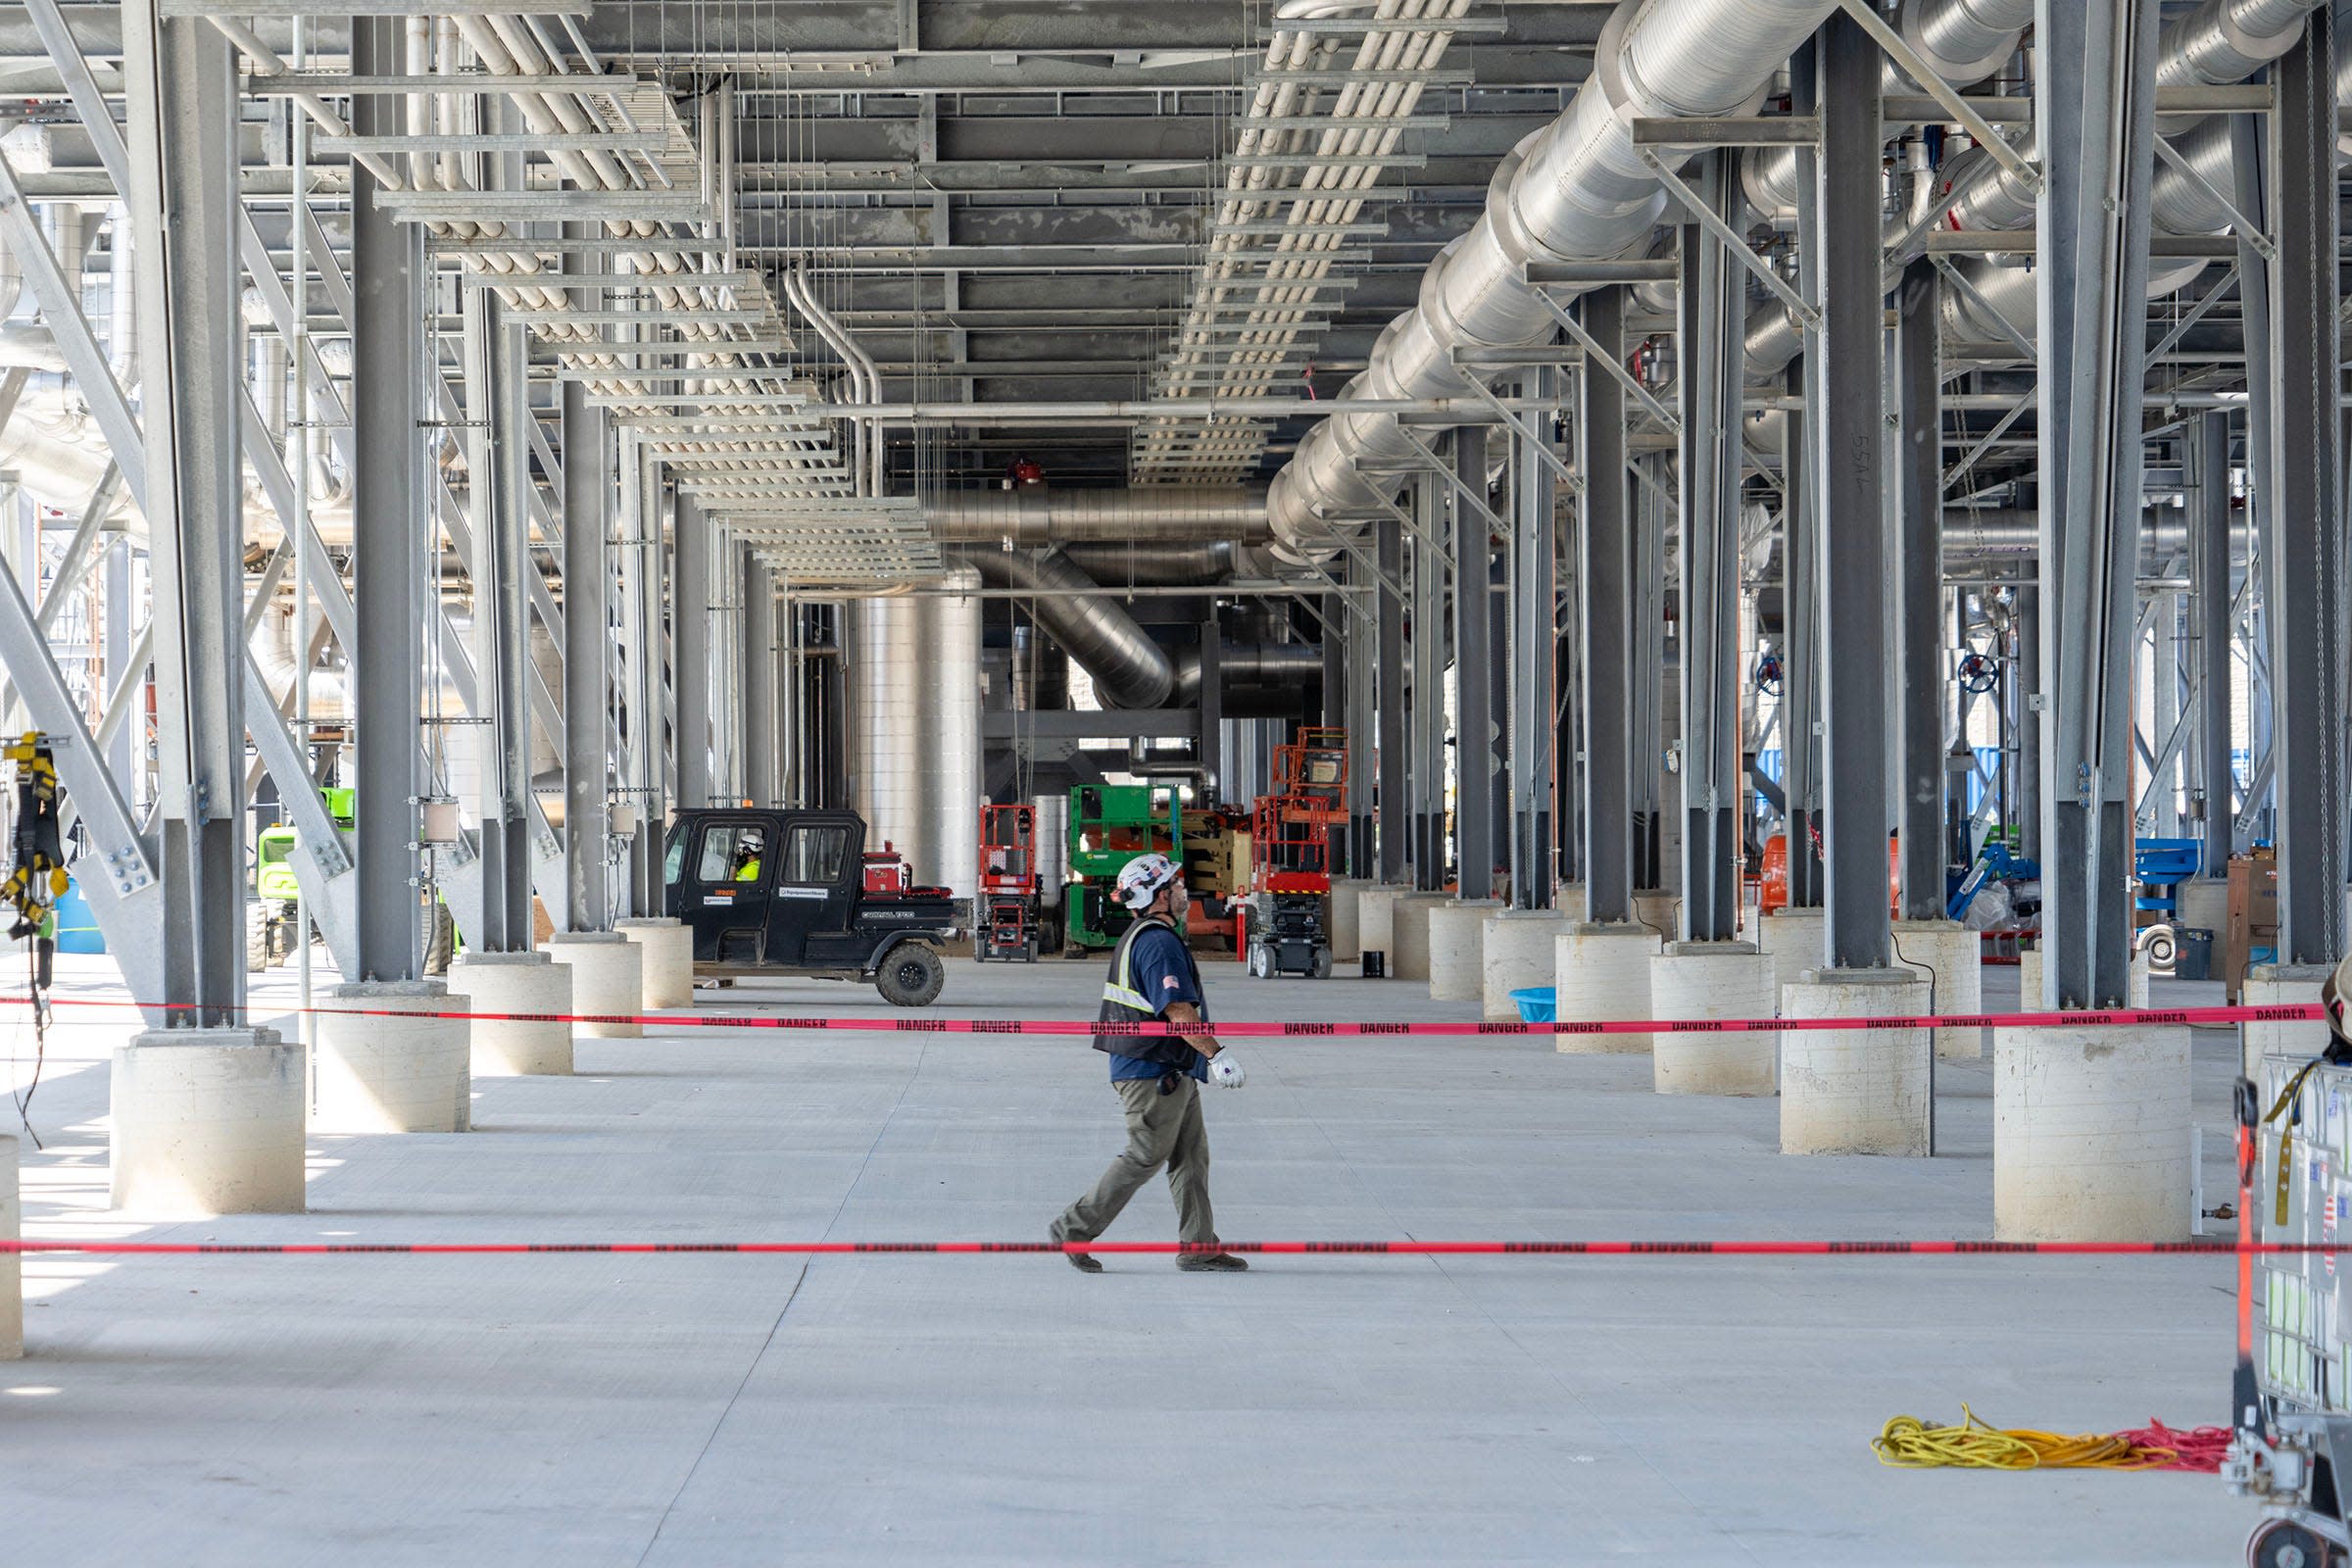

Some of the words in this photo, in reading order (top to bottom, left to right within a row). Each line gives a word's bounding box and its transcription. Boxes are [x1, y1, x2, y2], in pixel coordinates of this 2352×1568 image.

[896, 1020, 946, 1031] DANGER
[971, 1021, 1021, 1033] DANGER
[1090, 1022, 1141, 1035] DANGER
[1165, 1022, 1216, 1035] DANGER
[1285, 1023, 1335, 1035] DANGER
[1359, 1023, 1409, 1034] DANGER
[1478, 1023, 1528, 1034] DANGER
[1553, 1022, 1603, 1033] DANGER
[1672, 1021, 1722, 1030] DANGER
[1748, 1021, 1797, 1030] DANGER
[2136, 1013, 2186, 1022] DANGER
[2256, 1008, 2306, 1019] DANGER
